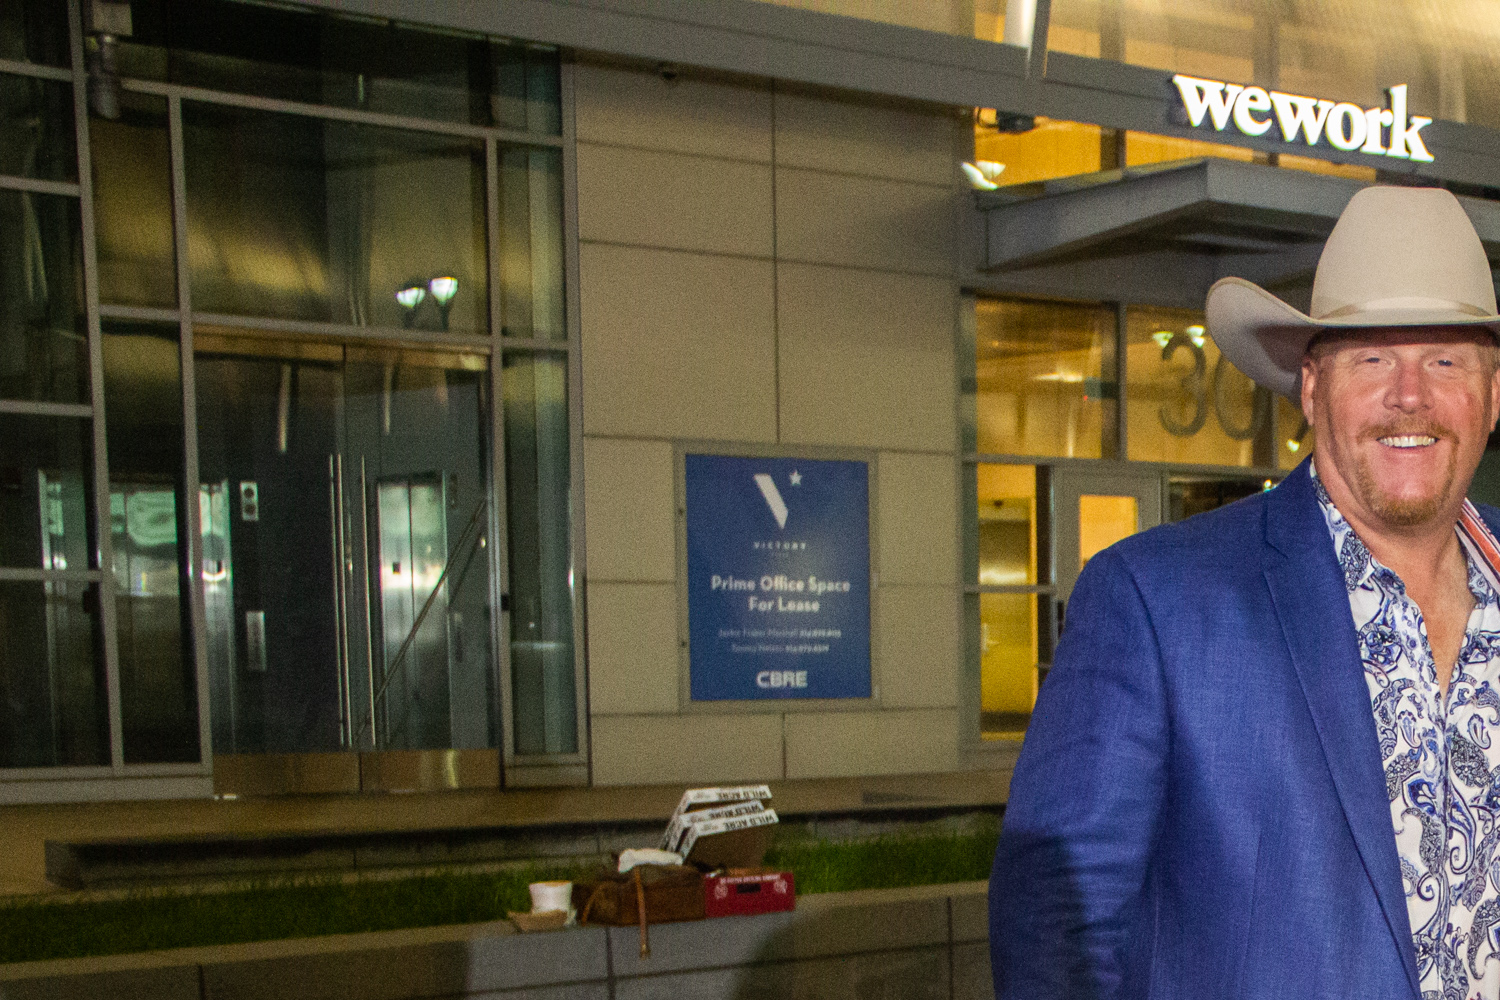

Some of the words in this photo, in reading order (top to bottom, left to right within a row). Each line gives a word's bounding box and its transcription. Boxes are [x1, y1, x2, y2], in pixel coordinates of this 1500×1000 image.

[1172, 74, 1434, 162] wework
[754, 541, 807, 550] VICTORY
[711, 574, 756, 592] Prime
[760, 574, 805, 593] Office
[808, 574, 850, 596] Space
[749, 595, 775, 612] For
[777, 595, 820, 613] Lease
[756, 669, 808, 689] CBRE
[723, 819, 748, 832] ACRE
[749, 814, 775, 827] WILD
